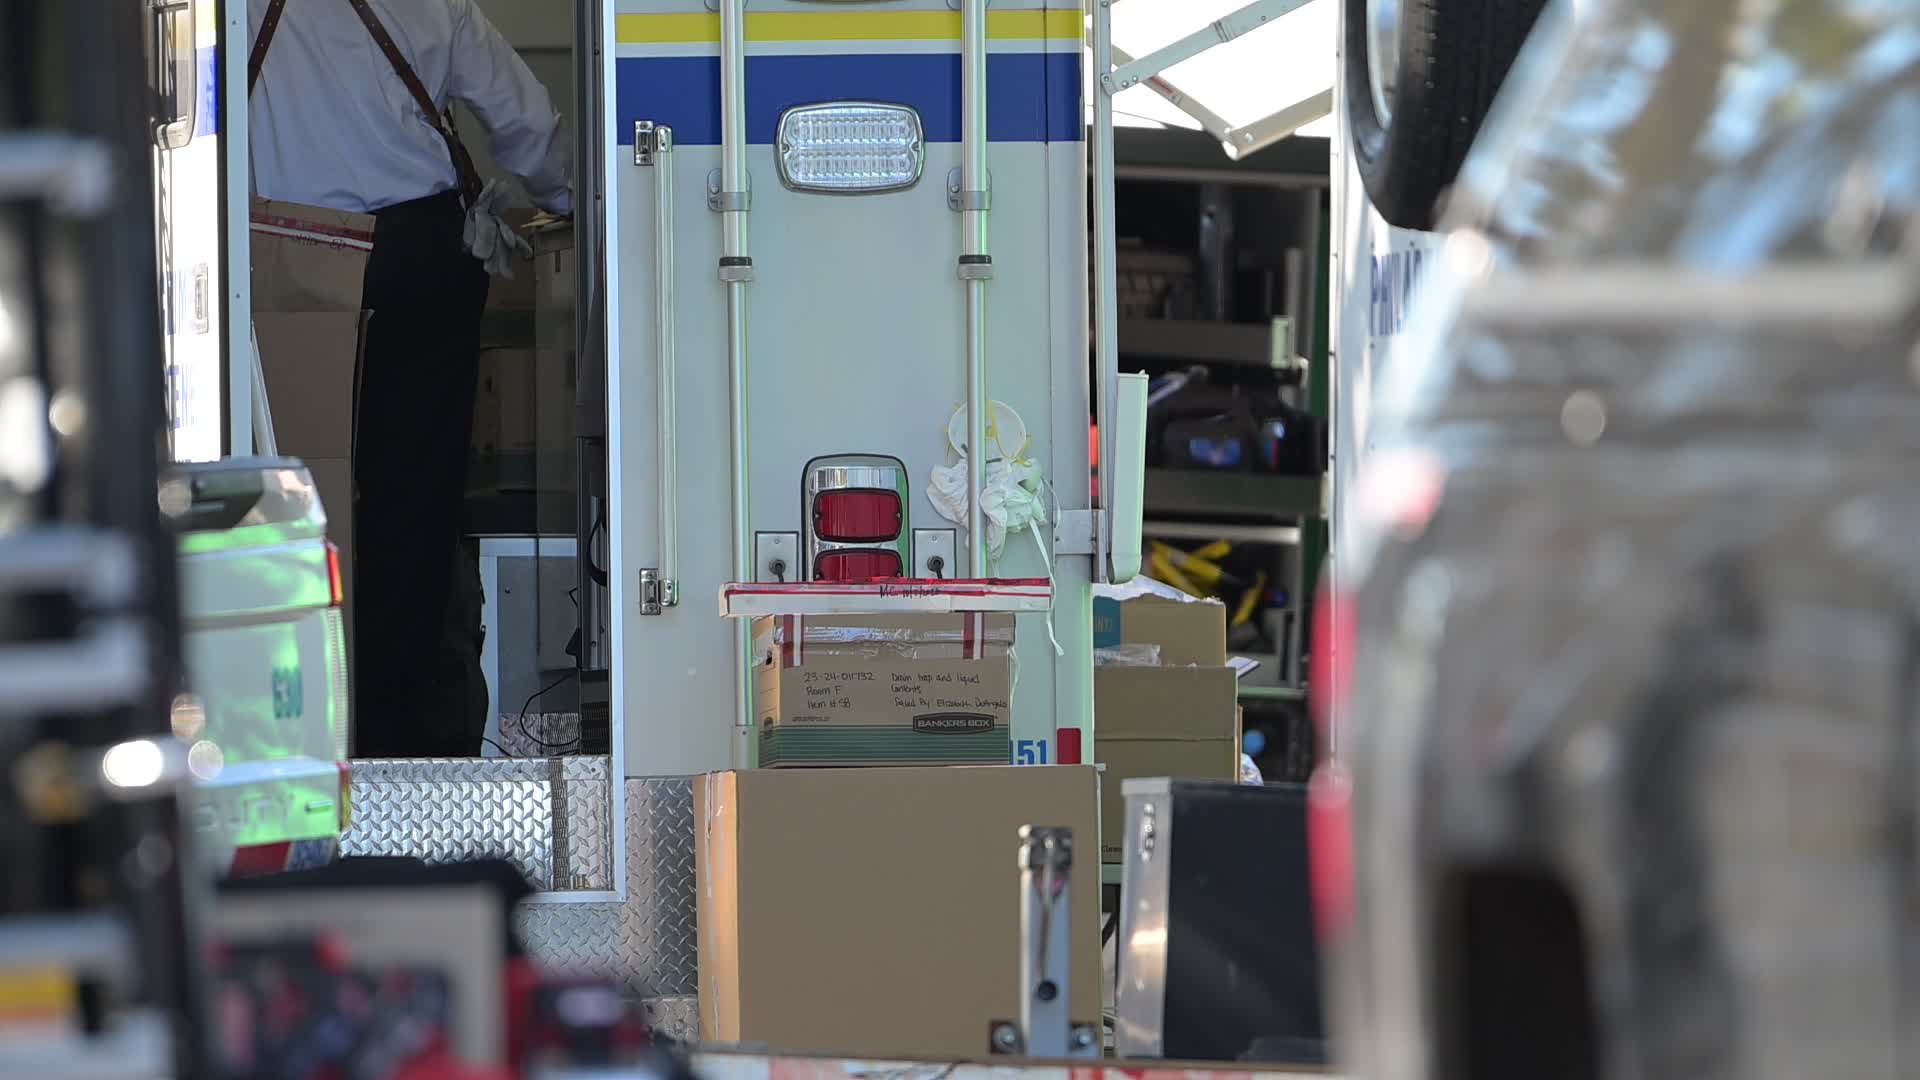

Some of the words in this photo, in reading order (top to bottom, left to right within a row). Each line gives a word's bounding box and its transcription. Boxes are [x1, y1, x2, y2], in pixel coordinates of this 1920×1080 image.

[935, 672, 953, 682] and
[806, 685, 831, 696] Room
[834, 685, 842, 695] F
[917, 719, 967, 728] BANKERS
[967, 719, 991, 728] BOX
[1009, 739, 1047, 765] 51
